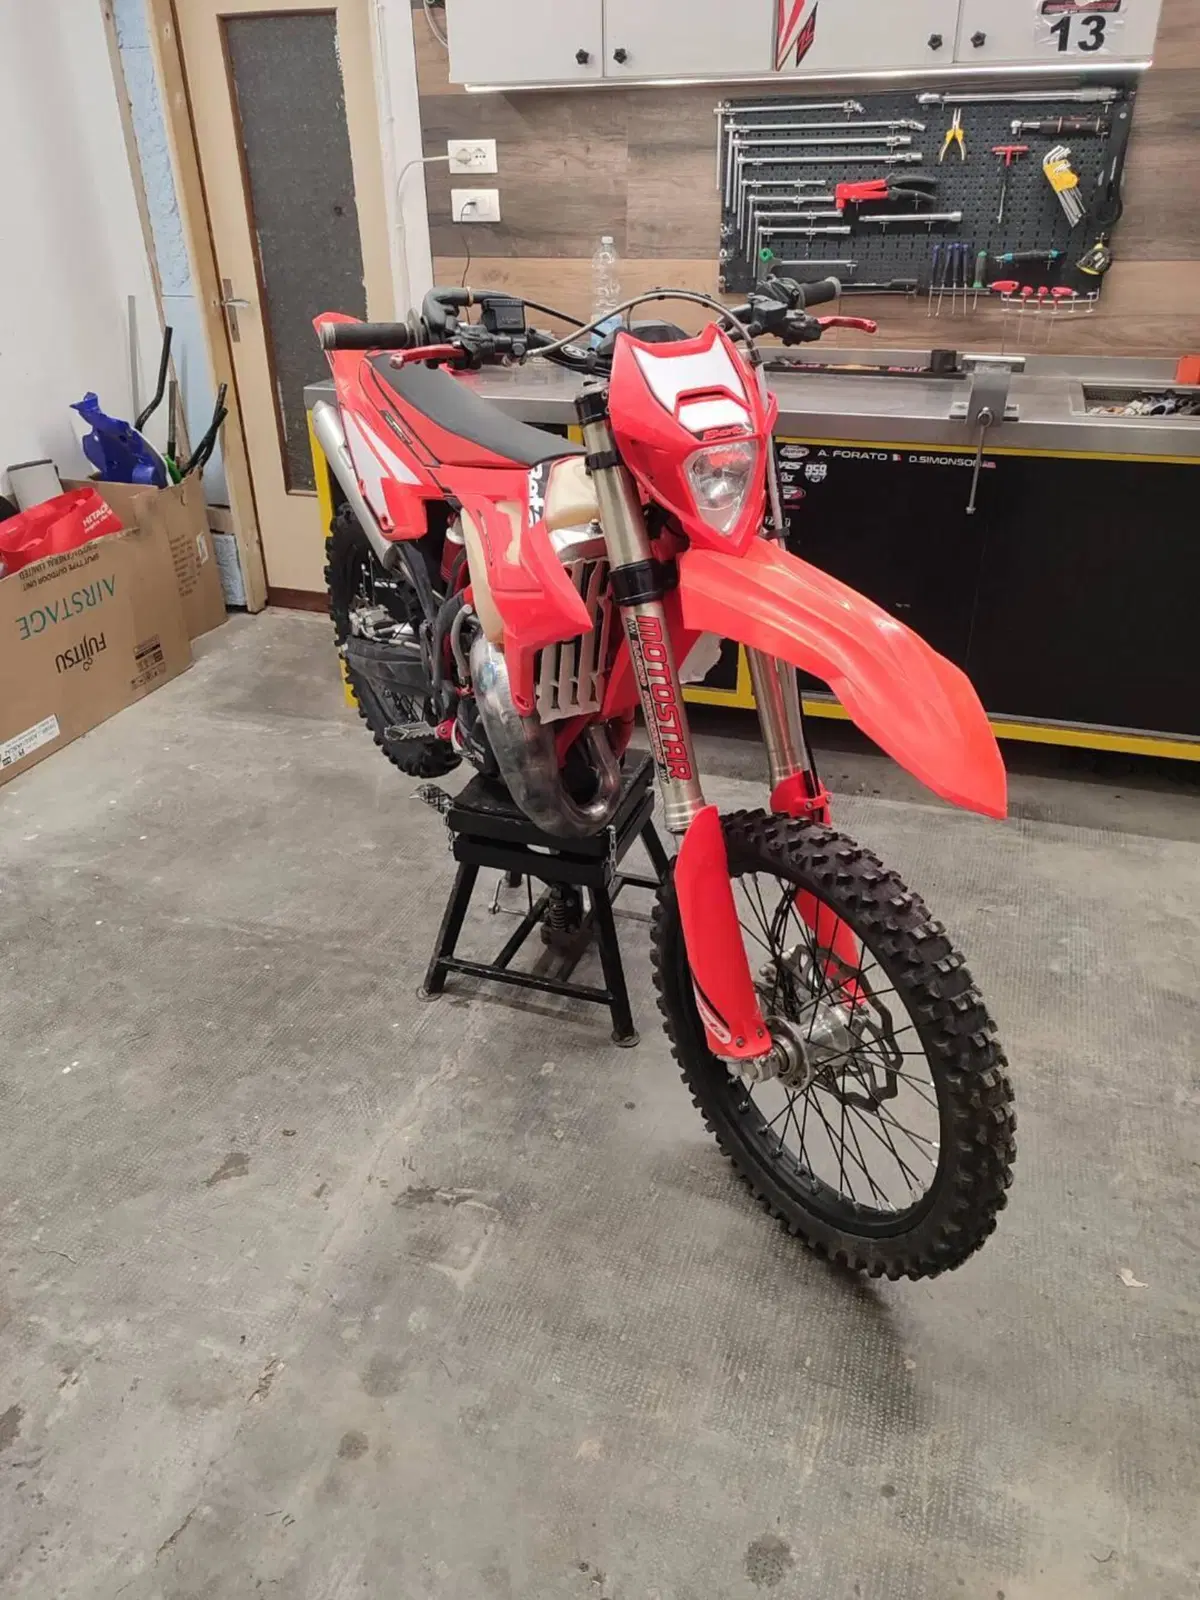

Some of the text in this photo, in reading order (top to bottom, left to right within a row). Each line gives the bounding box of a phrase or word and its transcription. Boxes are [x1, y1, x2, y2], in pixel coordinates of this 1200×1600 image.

[1050, 16, 1106, 51] 13
[805, 464, 828, 475] 959
[833, 450, 888, 461] FORATO
[15, 573, 115, 640] AIRSTAGE
[54, 632, 107, 673] FUJITSU
[636, 615, 691, 780] MOTOSTAR
